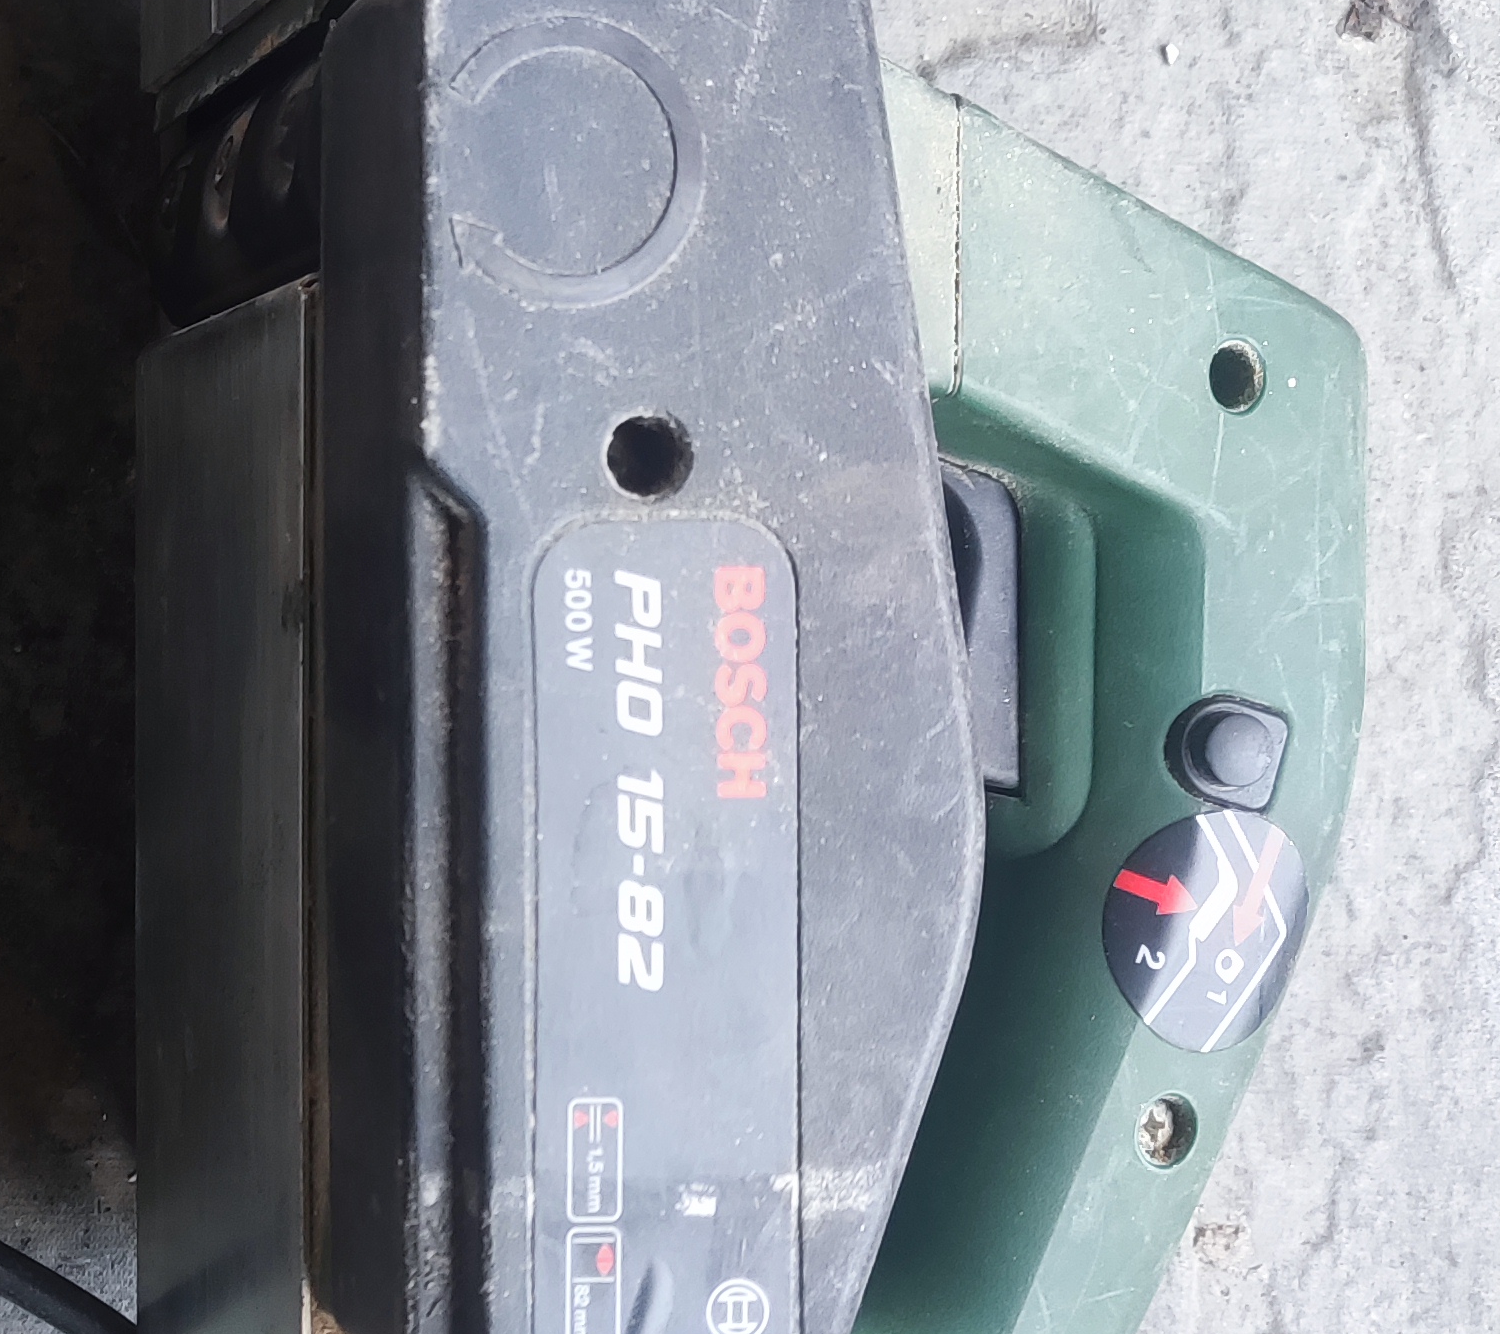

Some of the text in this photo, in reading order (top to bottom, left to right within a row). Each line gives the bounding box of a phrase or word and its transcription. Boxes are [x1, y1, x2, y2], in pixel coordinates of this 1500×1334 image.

[565, 569, 593, 672] 500 W
[714, 567, 767, 798] BOSCH
[615, 570, 664, 992] PHO 15-82
[1136, 945, 1165, 970] 2
[1207, 991, 1226, 1005] 1
[587, 1177, 601, 1213] mm
[574, 1285, 589, 1307] 82
